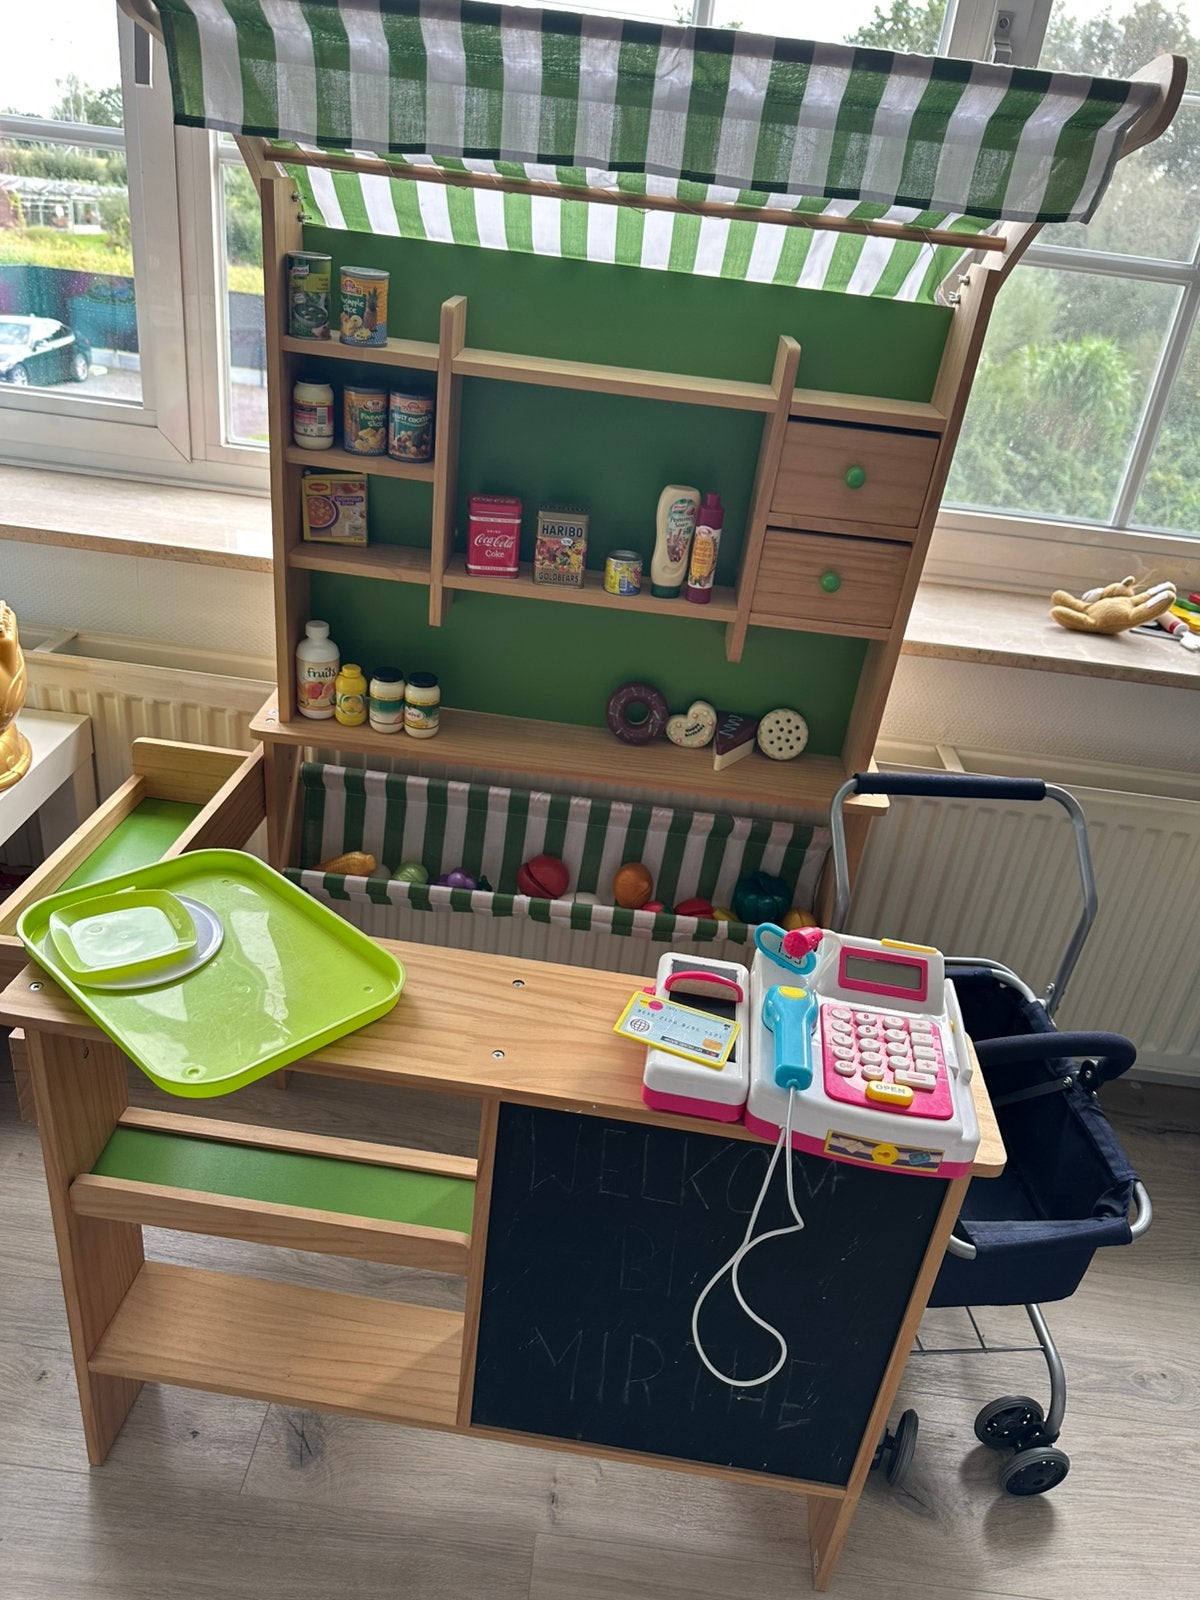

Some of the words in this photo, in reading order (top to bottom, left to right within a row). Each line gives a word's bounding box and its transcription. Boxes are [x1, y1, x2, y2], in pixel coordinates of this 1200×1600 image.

[541, 523, 584, 538] HARIBO
[485, 549, 505, 558] Coke
[538, 571, 579, 583] GOLDBEARS
[307, 666, 337, 680] fruits
[875, 1083, 907, 1095] OPEN
